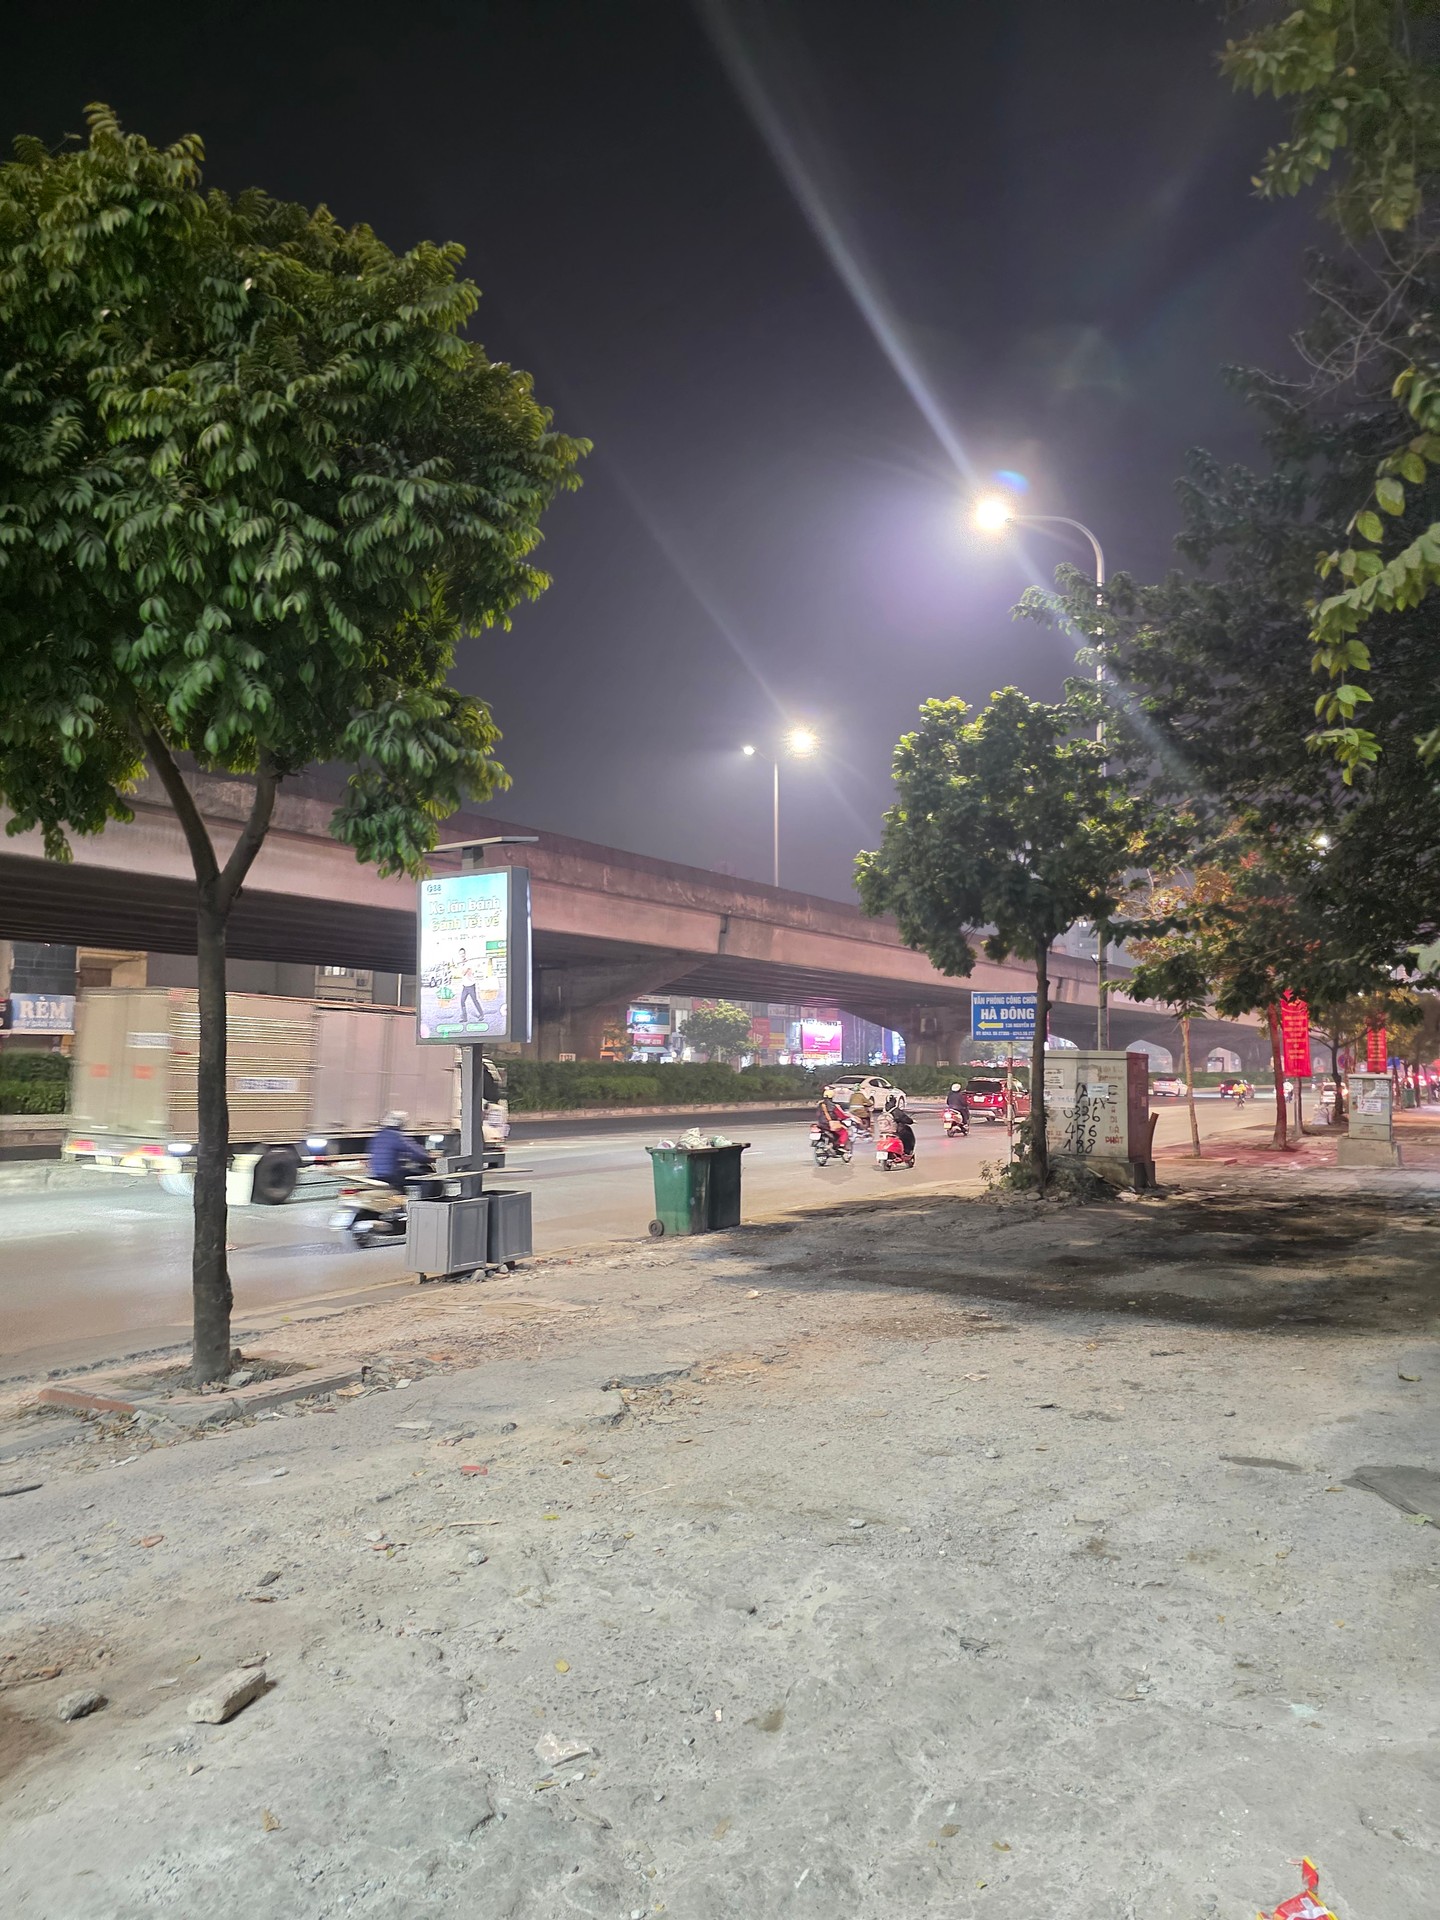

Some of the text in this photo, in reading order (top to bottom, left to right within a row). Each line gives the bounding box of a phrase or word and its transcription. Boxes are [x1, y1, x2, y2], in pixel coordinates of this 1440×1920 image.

[429, 900, 445, 915] Xe
[467, 895, 500, 911] bánh
[974, 996, 985, 1004] VĂN
[986, 996, 1005, 1004] PHÒNG
[1006, 996, 1021, 1004] CÔNG
[981, 1006, 1035, 1020] HÀ ĐÔNG
[1065, 1122, 1097, 1139] 456
[1064, 1138, 1096, 1154] 188
